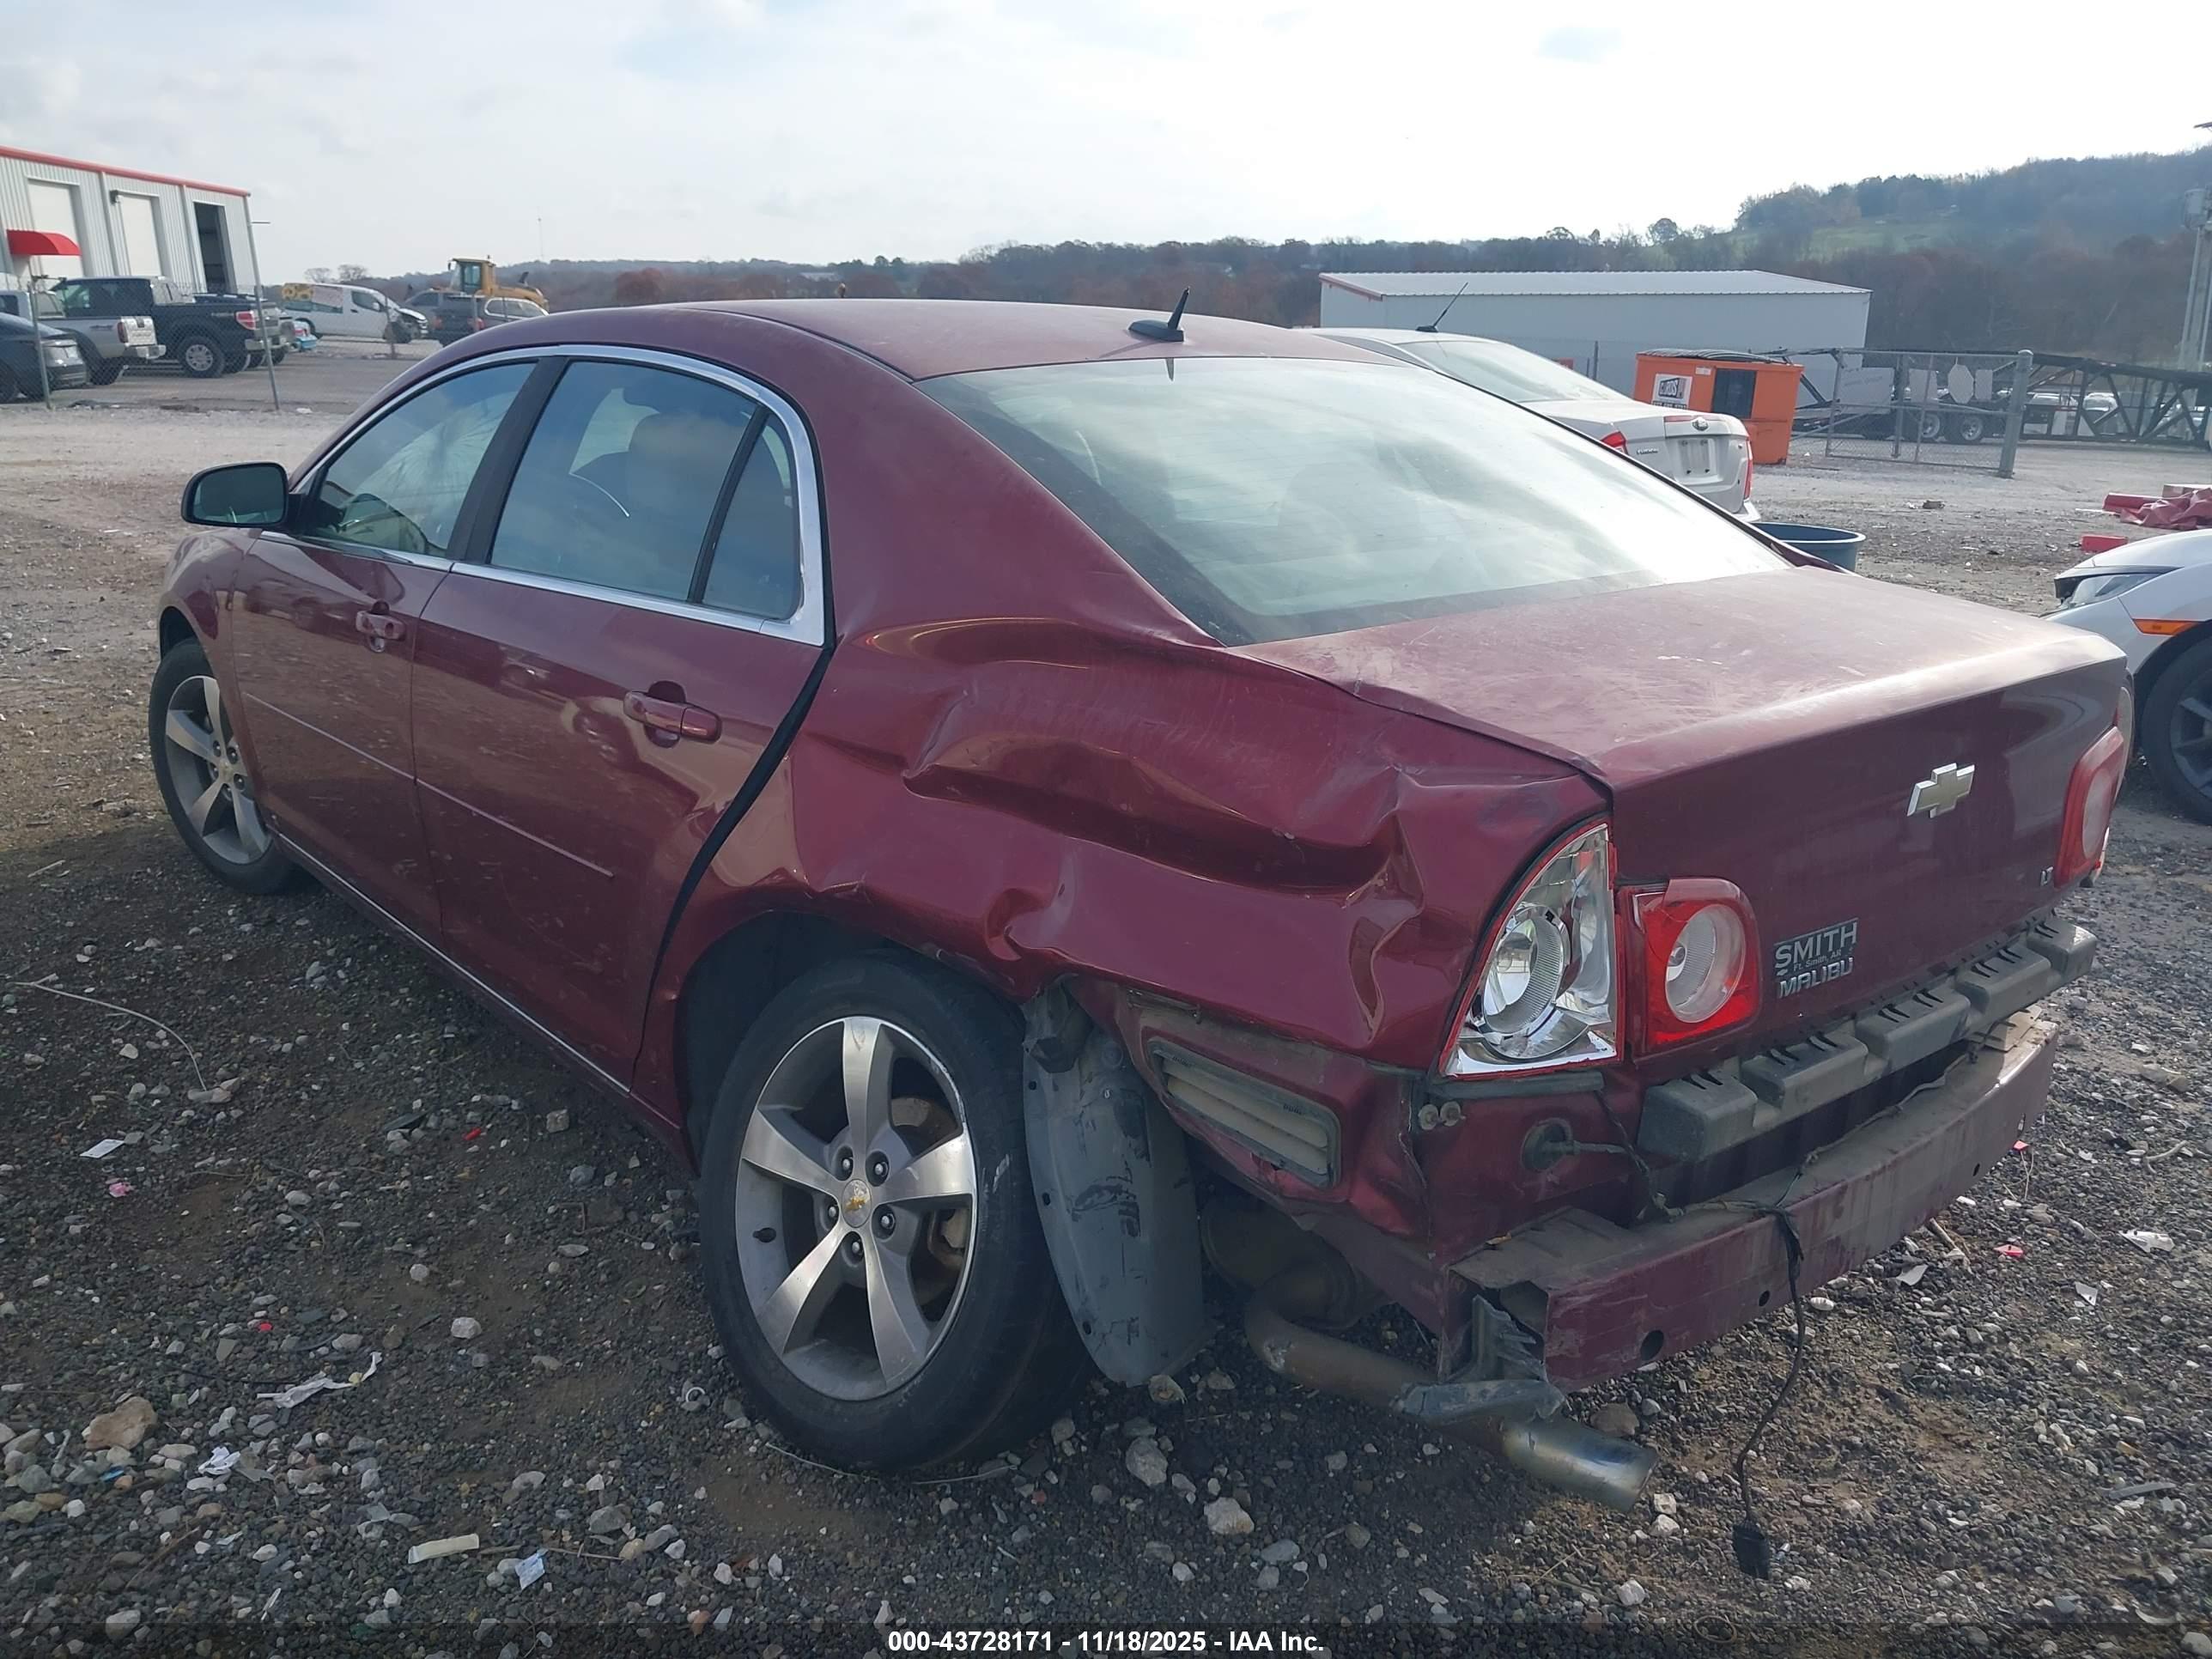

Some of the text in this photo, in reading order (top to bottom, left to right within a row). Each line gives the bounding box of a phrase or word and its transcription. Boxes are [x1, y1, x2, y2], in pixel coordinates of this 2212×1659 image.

[2040, 866, 2054, 886] LT
[1775, 921, 1857, 969] SMITH
[1830, 949, 1842, 959] AR
[1779, 957, 1854, 1000] MALIBU
